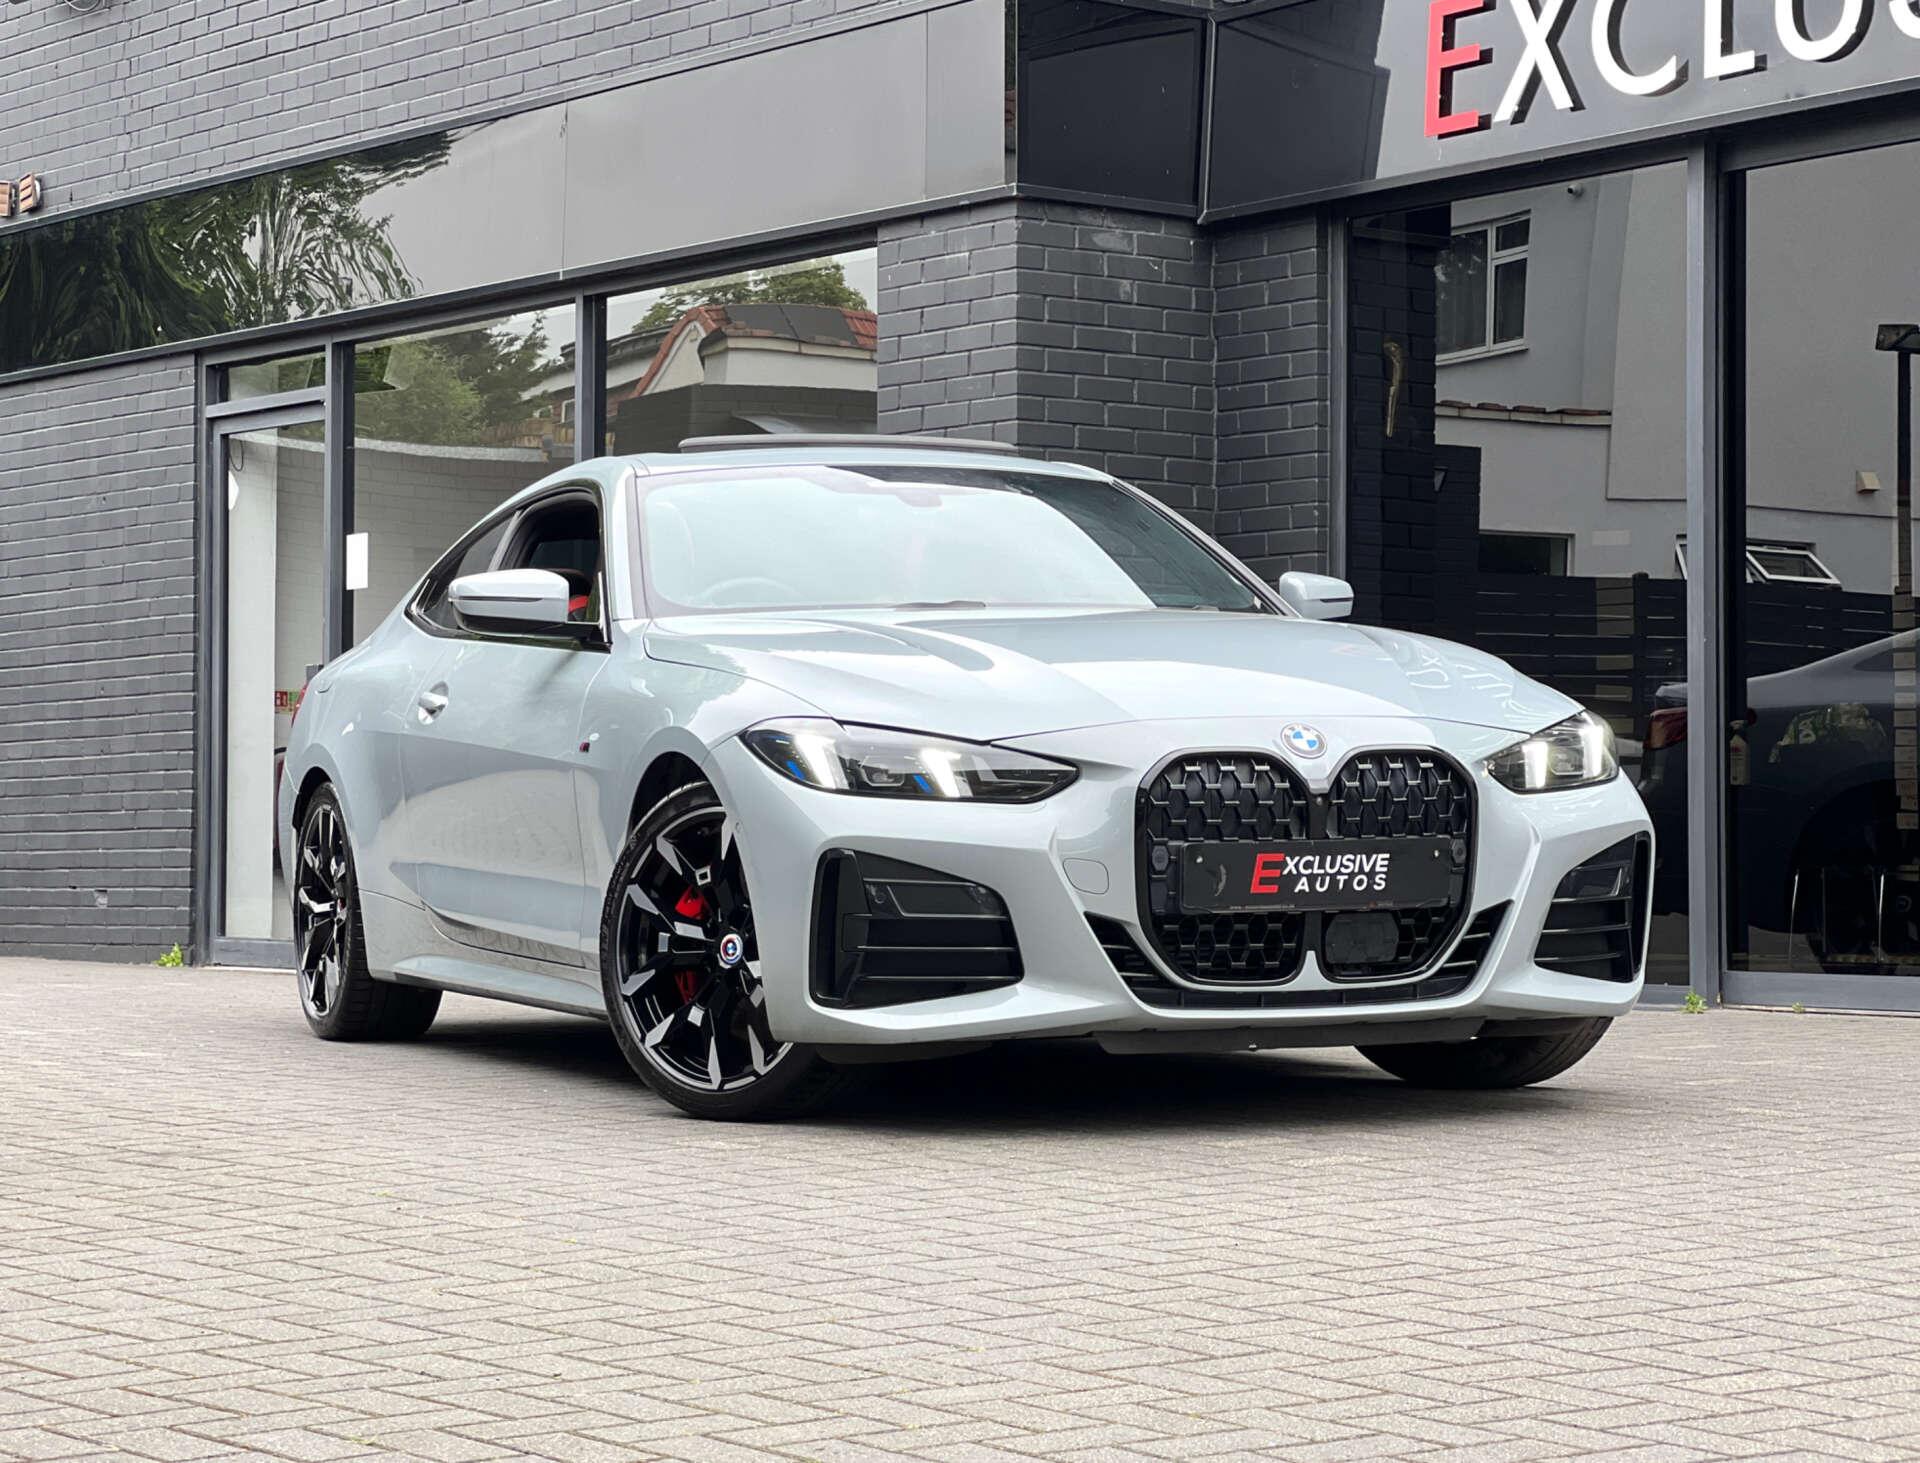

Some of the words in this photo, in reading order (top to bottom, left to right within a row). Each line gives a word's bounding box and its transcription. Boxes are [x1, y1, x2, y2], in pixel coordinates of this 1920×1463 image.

[1424, 0, 1920, 138] EXCL
[1250, 853, 1390, 893] EXCLUSIVE
[1293, 873, 1387, 893] AUTOS
